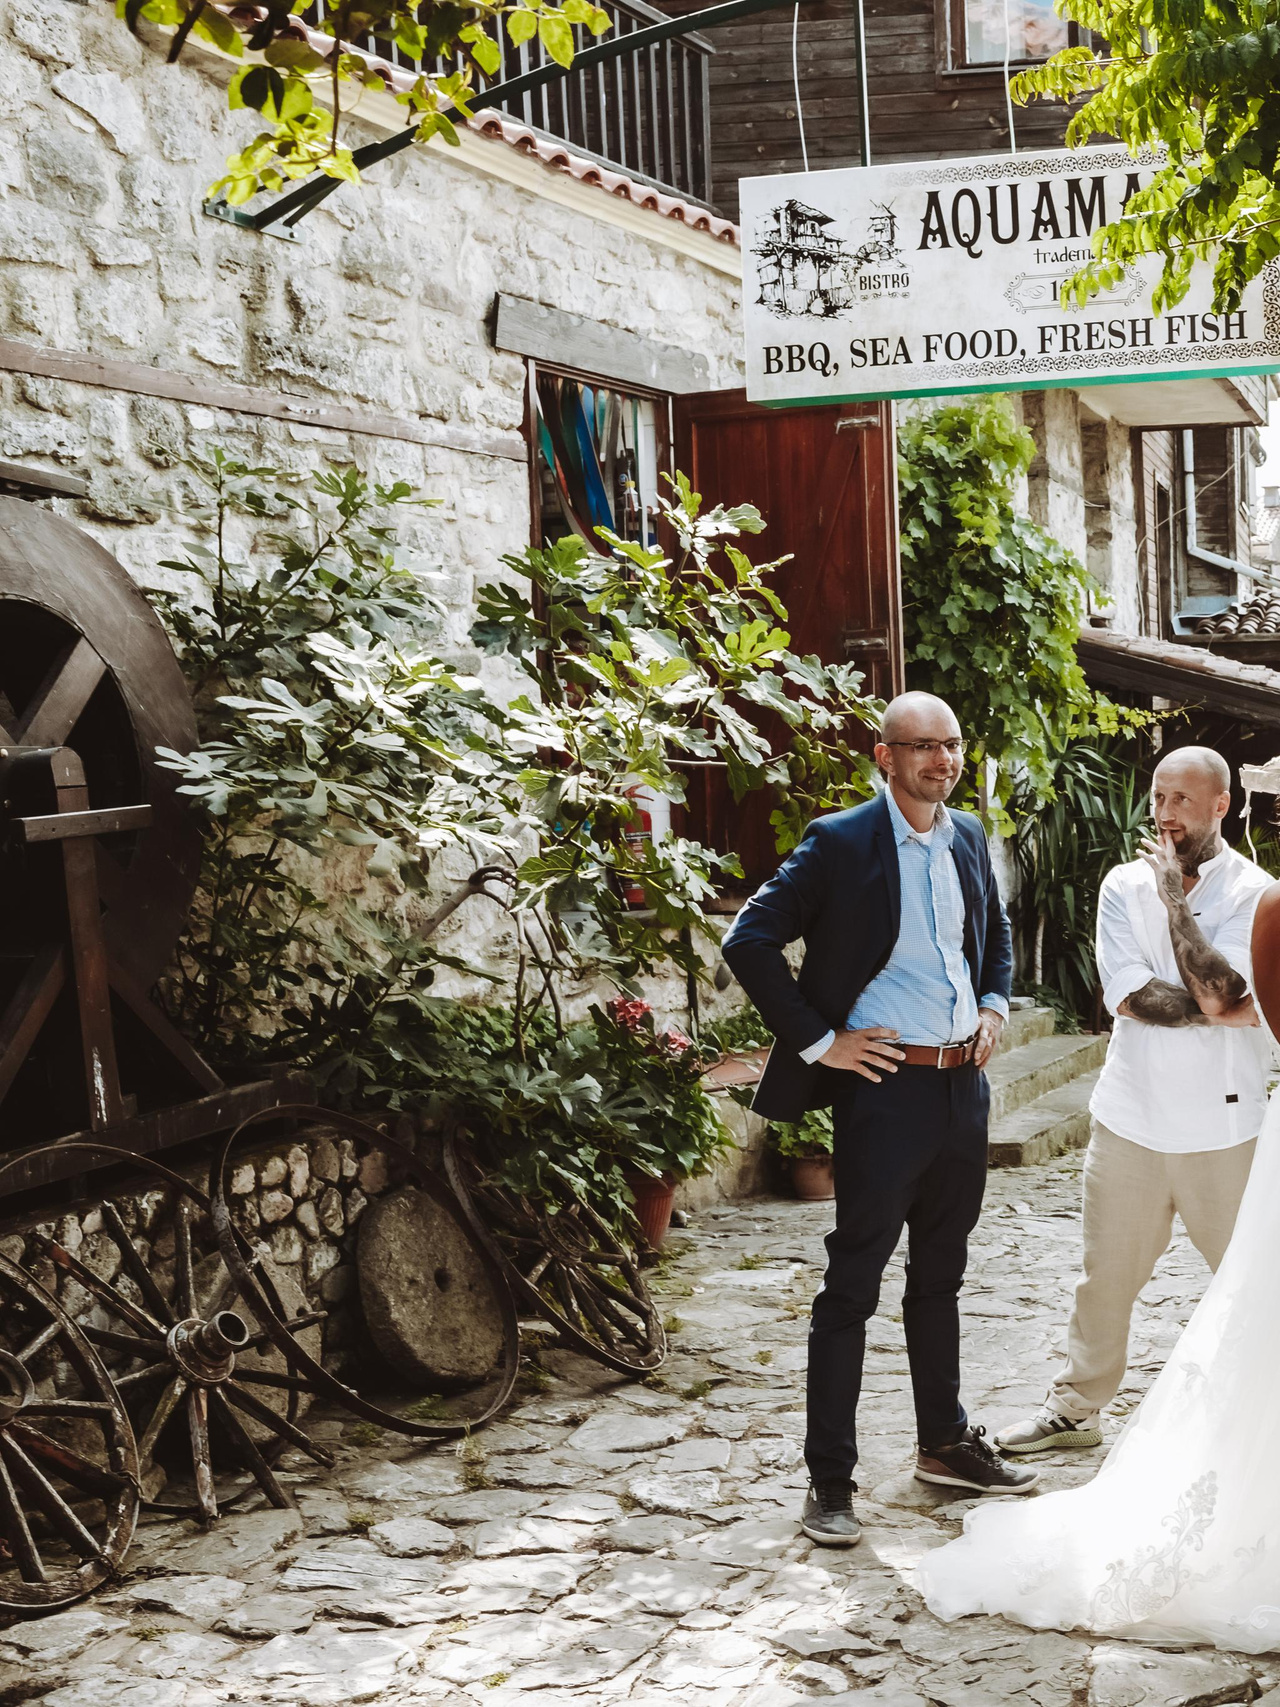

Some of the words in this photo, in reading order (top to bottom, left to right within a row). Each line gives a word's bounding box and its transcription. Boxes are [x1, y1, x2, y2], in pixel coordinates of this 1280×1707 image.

[859, 272, 910, 291] BISTRO
[762, 341, 840, 378] BBQ,
[849, 336, 913, 369] SEA
[922, 328, 1026, 362] FOOD,
[1037, 317, 1154, 355] FRESH
[1164, 309, 1249, 345] FISH
